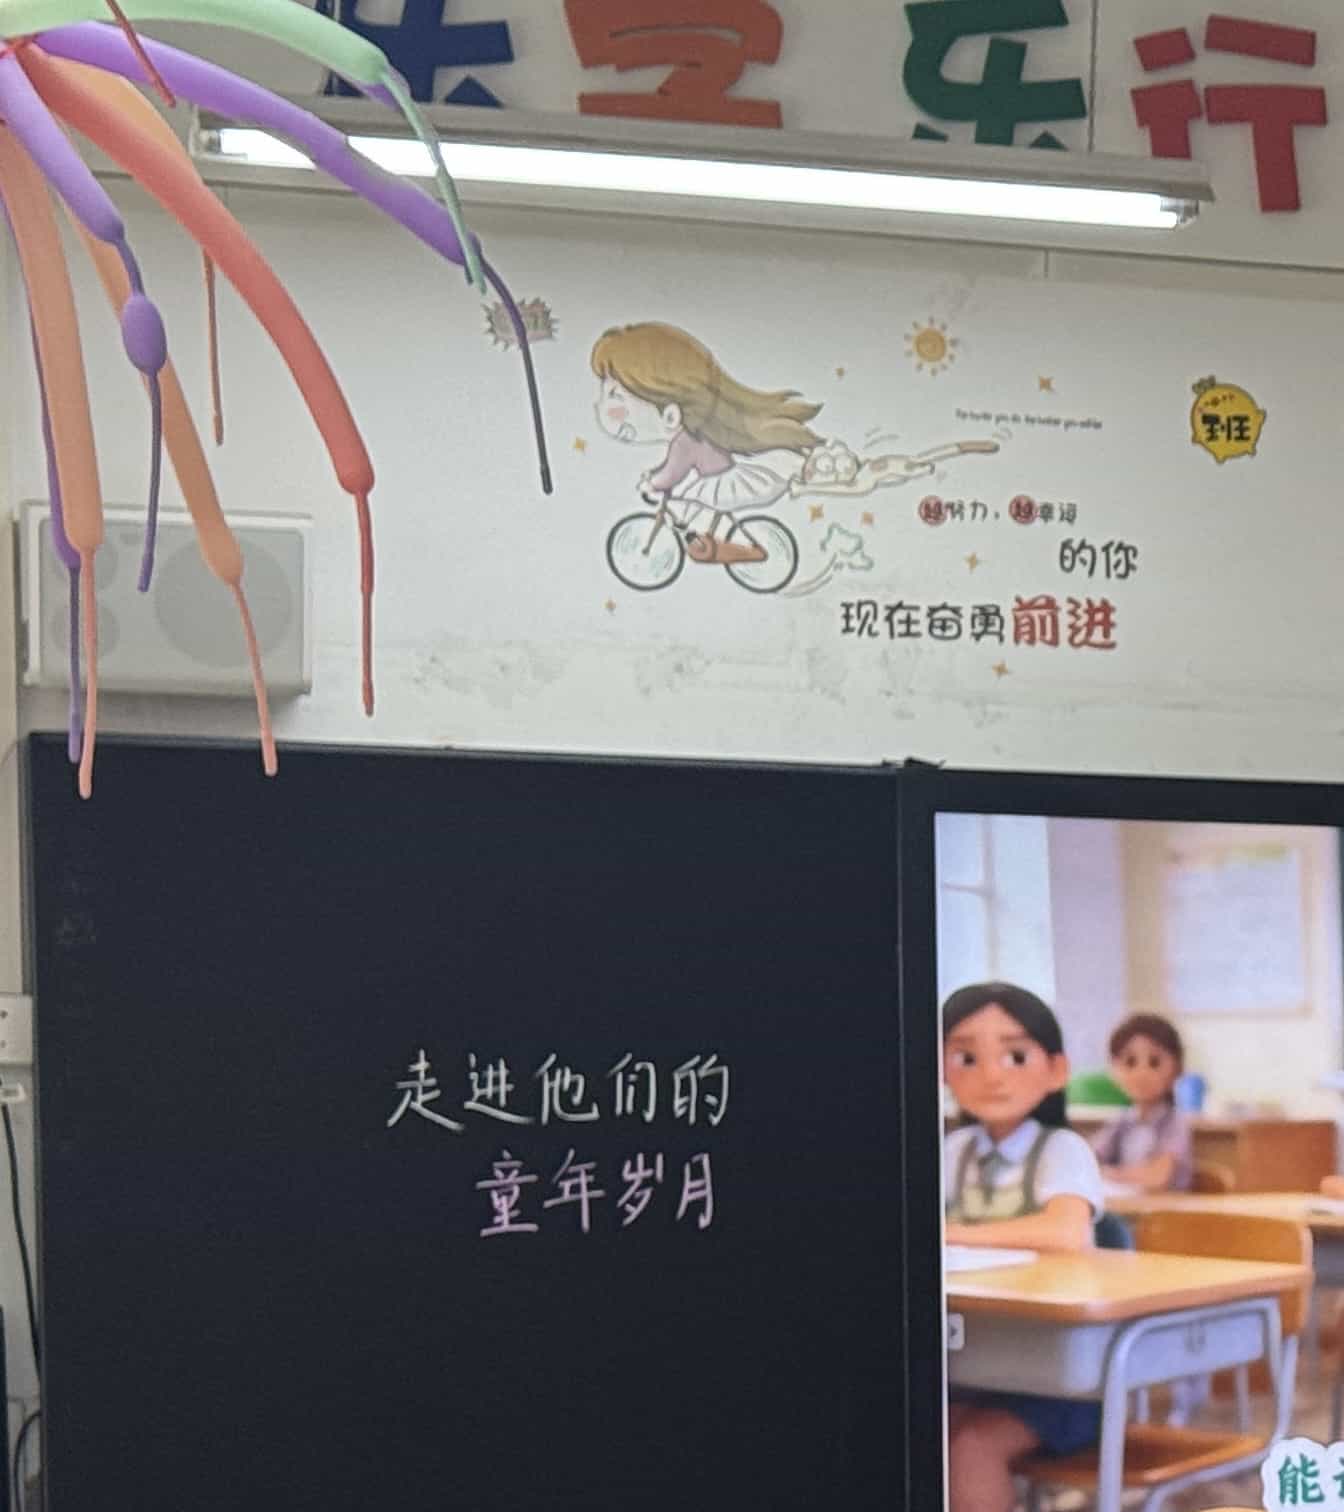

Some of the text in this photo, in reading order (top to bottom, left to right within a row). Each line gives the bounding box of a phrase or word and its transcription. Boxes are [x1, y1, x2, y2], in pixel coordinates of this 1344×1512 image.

[1059, 537, 1138, 579] 的你
[839, 595, 1117, 650] 现在奋勇前进
[386, 1049, 730, 1132] 走进他们的
[474, 1148, 715, 1237] 童年岁月
